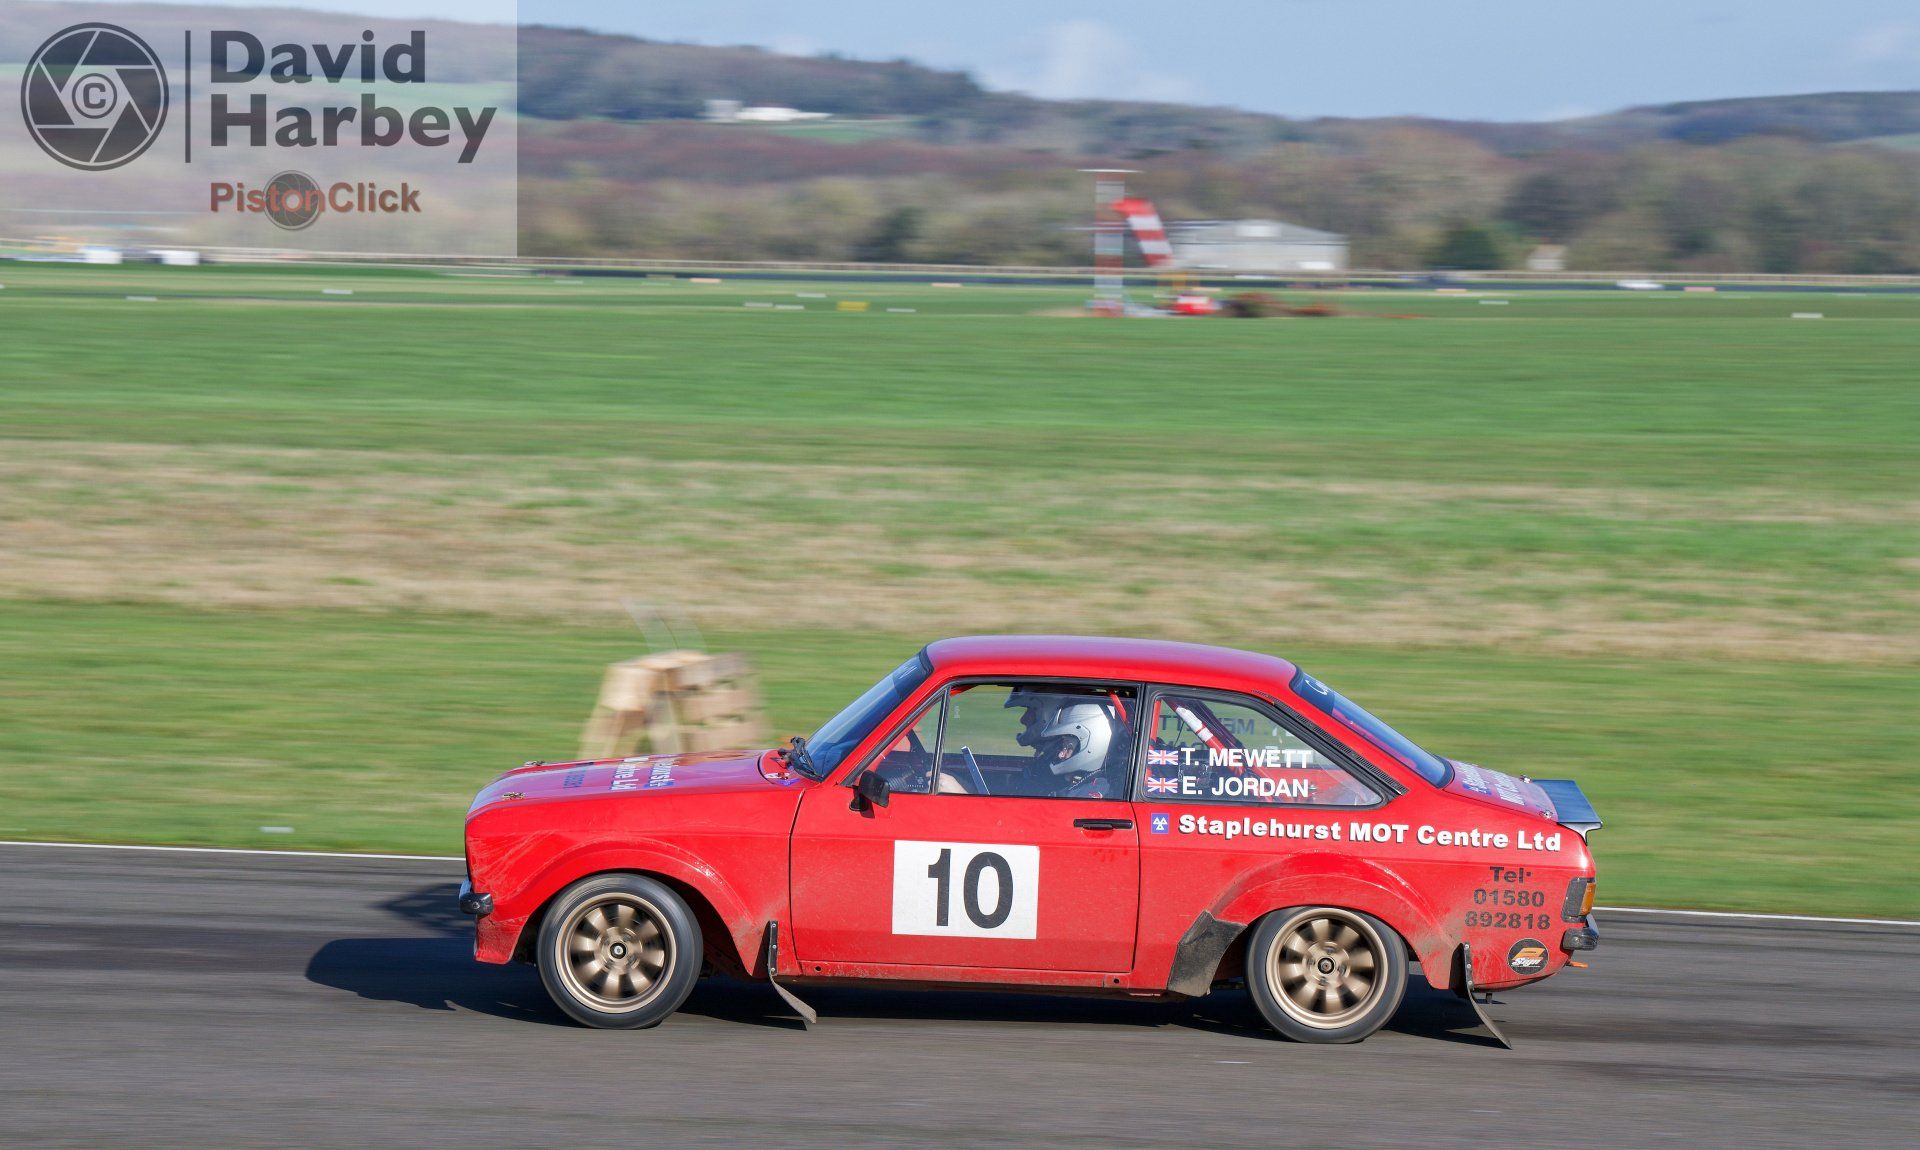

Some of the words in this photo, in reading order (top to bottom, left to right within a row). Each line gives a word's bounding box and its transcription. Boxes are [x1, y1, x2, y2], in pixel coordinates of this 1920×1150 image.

[1180, 748, 1200, 766] T.
[1209, 748, 1312, 769] MEWETT
[1182, 775, 1203, 795] E.
[1211, 776, 1309, 798] JORDAN
[1178, 814, 1342, 840] Staplehurst
[1349, 822, 1409, 843] MOT
[1417, 825, 1509, 848] Centre
[1517, 831, 1561, 851] Ltd
[927, 848, 1014, 929] 10
[1473, 888, 1545, 907] 01580
[1464, 910, 1551, 930] 892818
